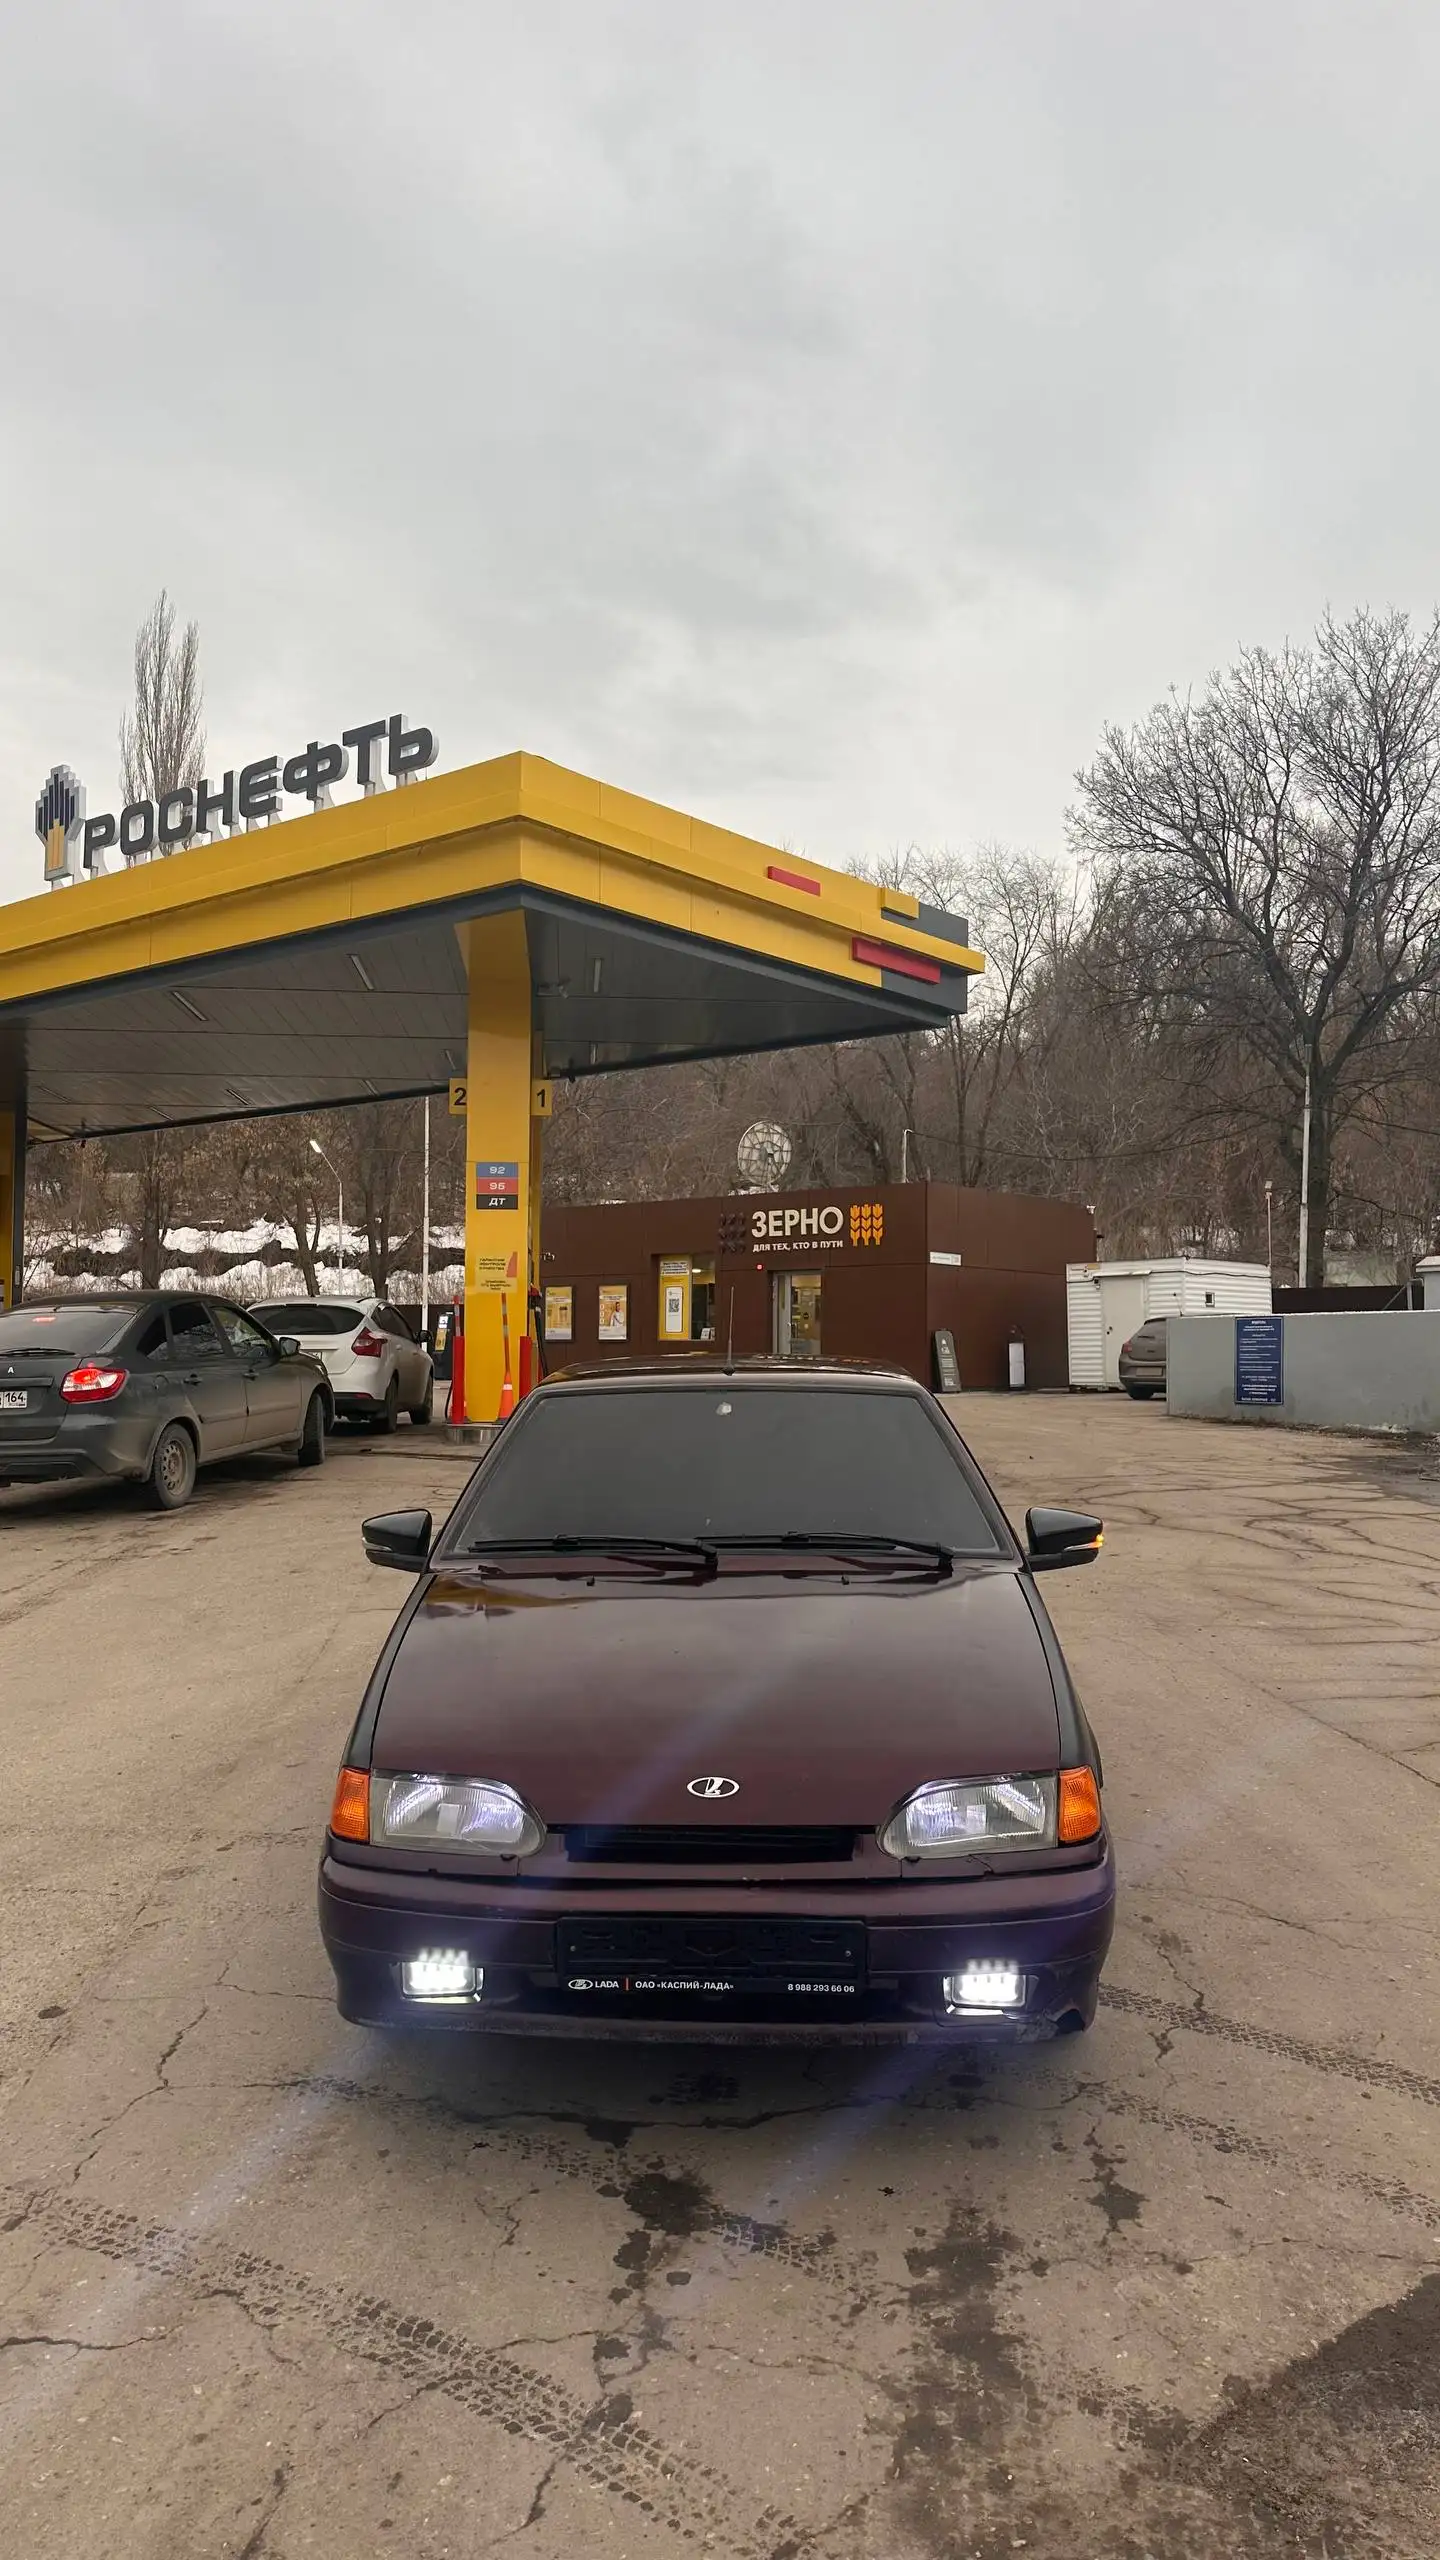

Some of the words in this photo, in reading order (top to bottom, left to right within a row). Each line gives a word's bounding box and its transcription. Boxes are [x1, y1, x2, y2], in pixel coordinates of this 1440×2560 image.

[84, 713, 440, 869] РОСНЕФТЬ
[453, 1087, 467, 1106] 2
[537, 1088, 546, 1107] 1
[489, 1166, 506, 1174] 92
[488, 1197, 506, 1206] ДТ
[751, 1206, 844, 1238] ЗЕРНО
[752, 1243, 770, 1252] ДЛЯ
[772, 1242, 791, 1251] ТЕХ,
[792, 1241, 810, 1250] КТО
[811, 1241, 818, 1249] В
[820, 1240, 844, 1248] ПУТИ
[5, 1392, 24, 1402] 164
[594, 1980, 619, 1988] LADA
[635, 1981, 655, 1989] ОАО
[787, 1983, 794, 1991] 8
[795, 1983, 812, 1992] 988
[813, 1984, 830, 1992] 293
[843, 1985, 855, 1993] 06
